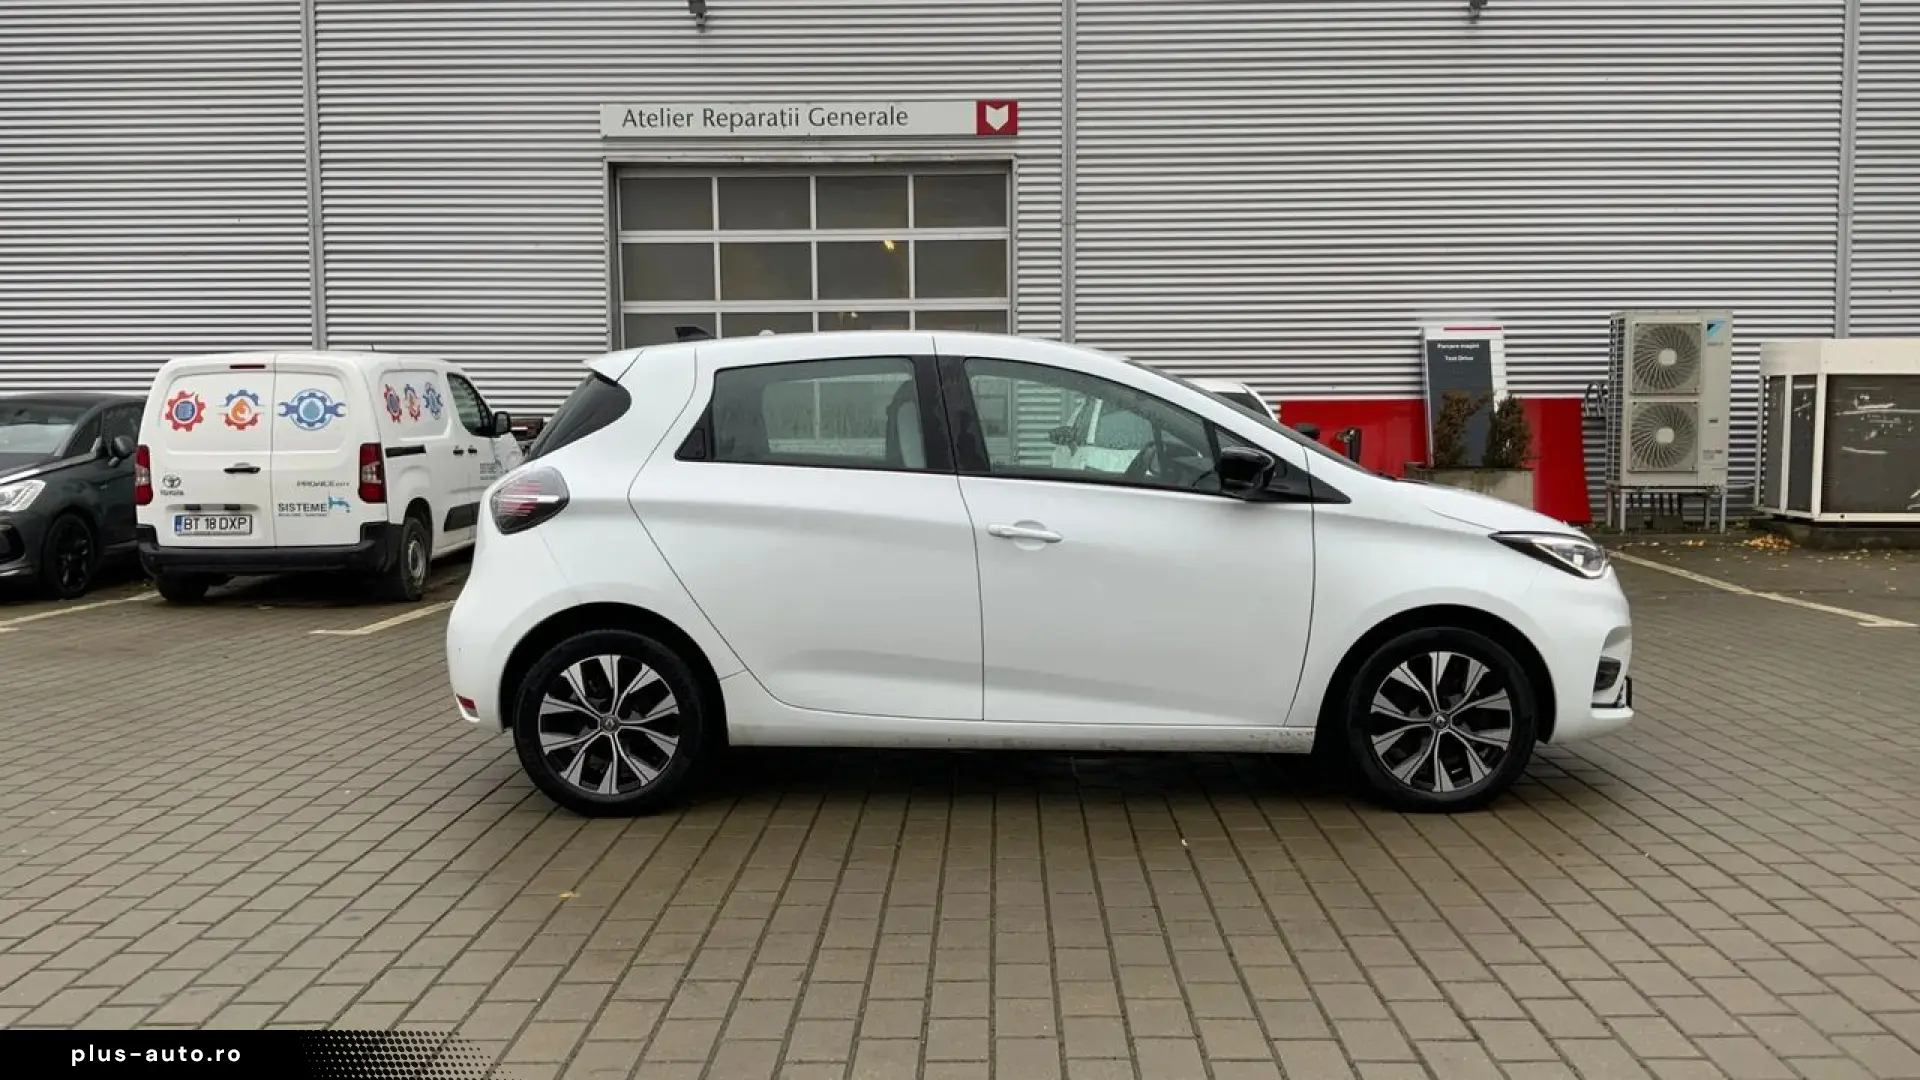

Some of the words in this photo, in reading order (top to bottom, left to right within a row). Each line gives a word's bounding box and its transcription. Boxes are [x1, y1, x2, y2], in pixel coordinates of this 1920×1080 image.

[622, 107, 693, 128] Atelier
[808, 105, 909, 127] Generale
[278, 503, 327, 512] SISTEME
[184, 517, 200, 530] BT
[204, 517, 217, 530] 18
[219, 516, 247, 530] DXP
